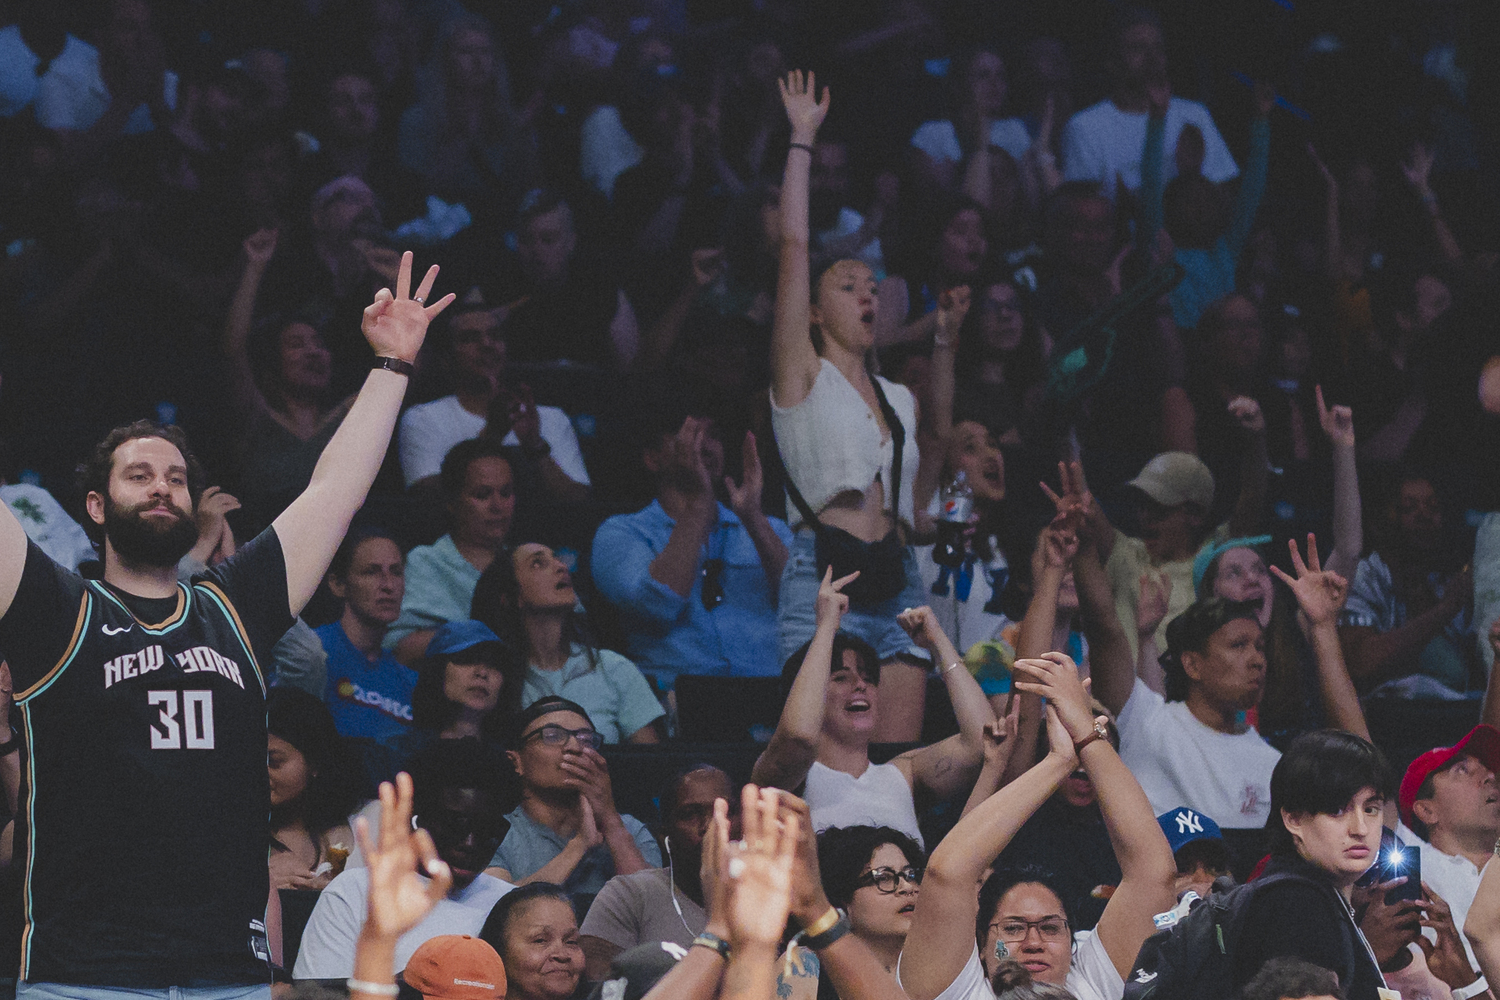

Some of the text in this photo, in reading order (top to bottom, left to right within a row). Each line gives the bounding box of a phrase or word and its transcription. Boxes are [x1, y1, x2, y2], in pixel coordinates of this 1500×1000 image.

[104, 645, 245, 690] NEW YORK
[148, 690, 215, 749] 30
[1175, 810, 1204, 834] NY
